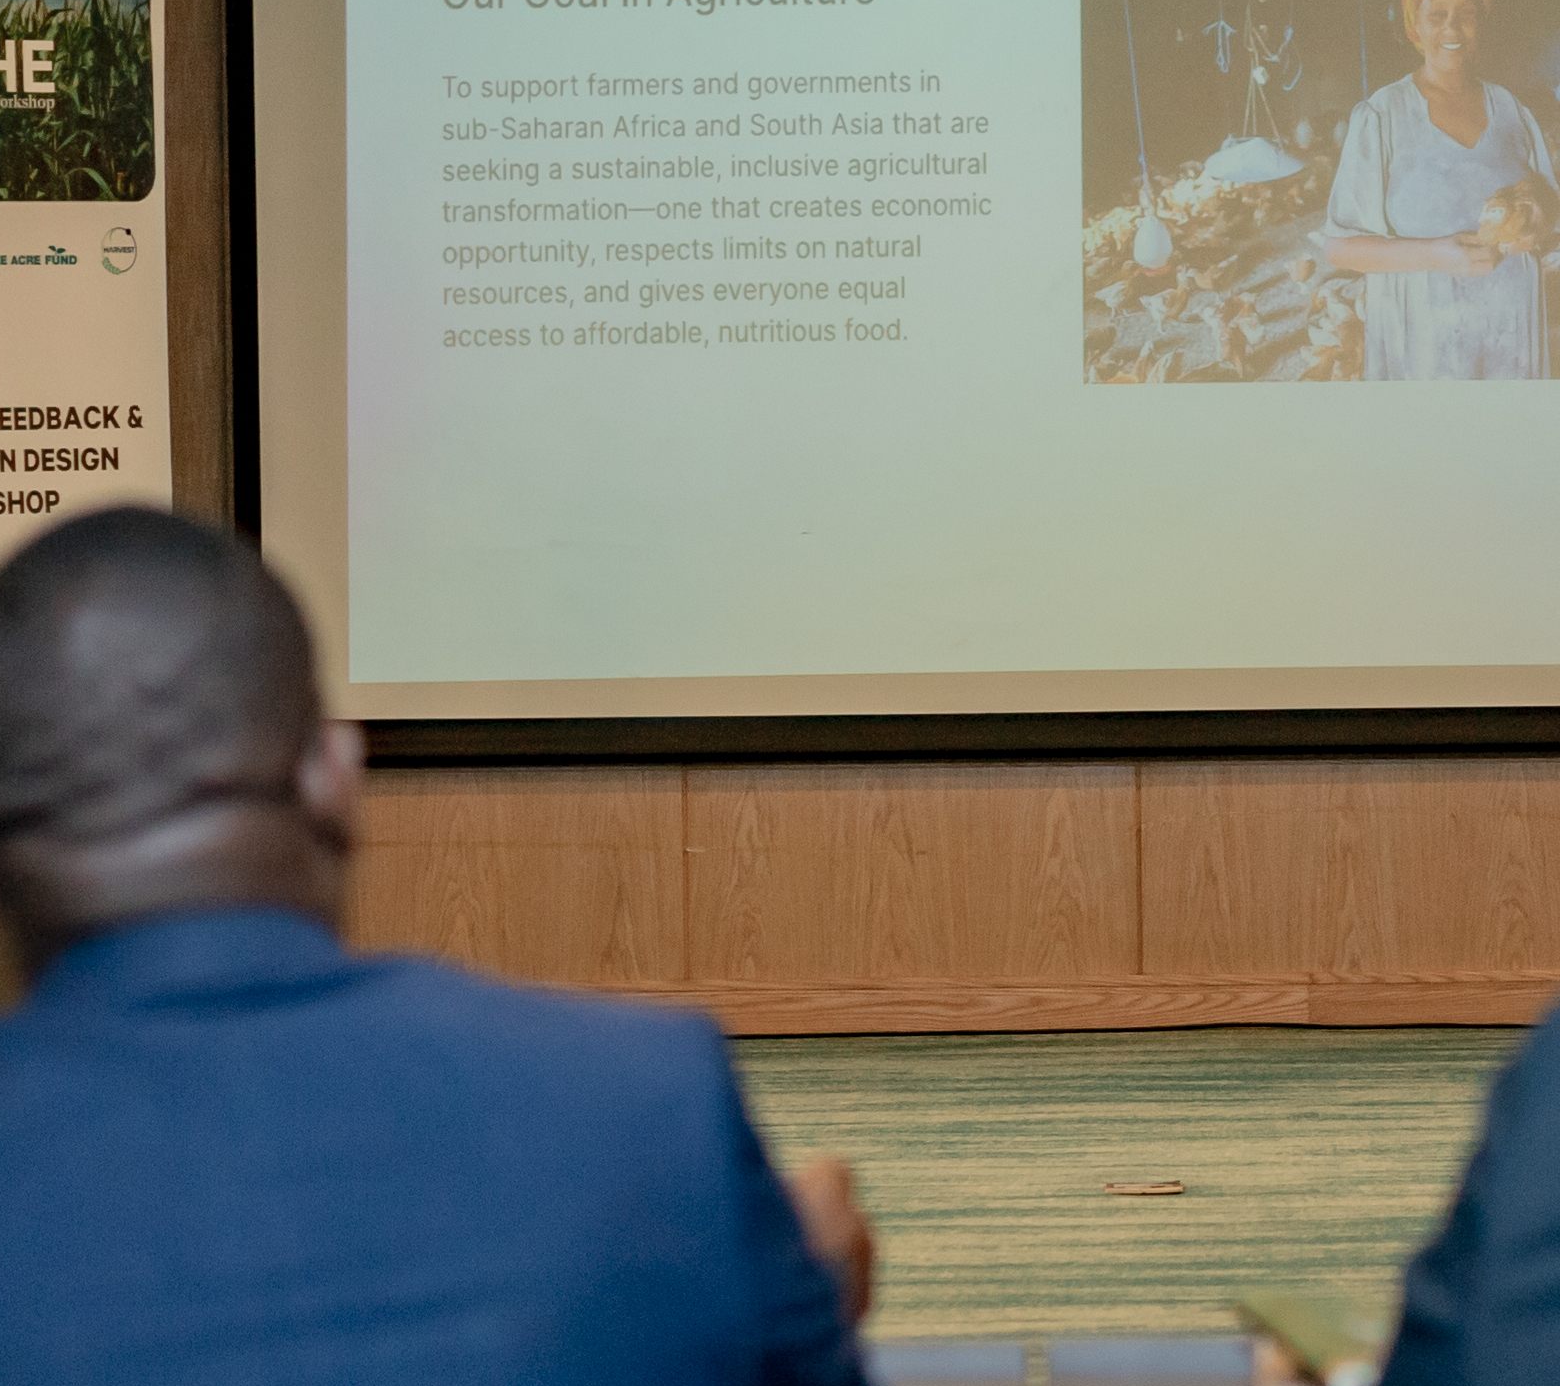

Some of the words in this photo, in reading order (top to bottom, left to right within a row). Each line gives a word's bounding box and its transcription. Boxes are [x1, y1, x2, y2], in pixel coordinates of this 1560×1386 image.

[442, 75, 472, 98] To
[481, 75, 579, 104] support
[588, 73, 684, 97] farmers
[693, 72, 738, 95] and
[747, 72, 911, 101] governments
[920, 69, 941, 93] in
[442, 116, 604, 141] sub-Saharan
[613, 114, 686, 138] Africa
[695, 114, 740, 137] and
[750, 113, 822, 136] South
[831, 112, 883, 135] Asia
[892, 112, 942, 135] that
[951, 115, 989, 134] are
[442, 158, 540, 187] seeking
[549, 162, 562, 180] a
[572, 156, 721, 183] sustainable,
[731, 153, 839, 178] inclusive
[848, 152, 988, 182] agricultural
[711, 196, 760, 219] that
[769, 196, 862, 218] creates
[871, 192, 992, 217] economic
[11, 255, 41, 265] ACRE
[45, 255, 77, 265] FUND
[442, 239, 595, 269] opportunity,
[606, 239, 714, 266] respects
[723, 236, 787, 260] limits
[796, 240, 825, 259] on
[835, 235, 921, 258] natural
[442, 285, 574, 309] resources,
[584, 280, 629, 303] and
[640, 279, 704, 308] gives
[713, 281, 829, 306] everyone
[838, 276, 905, 305] equal
[442, 328, 531, 348] access
[540, 324, 564, 346] to
[573, 321, 709, 349] affordable,
[719, 319, 836, 343] nutritious
[844, 318, 908, 341] food.
[127, 405, 143, 429] &
[24, 447, 119, 473] DESIGN
